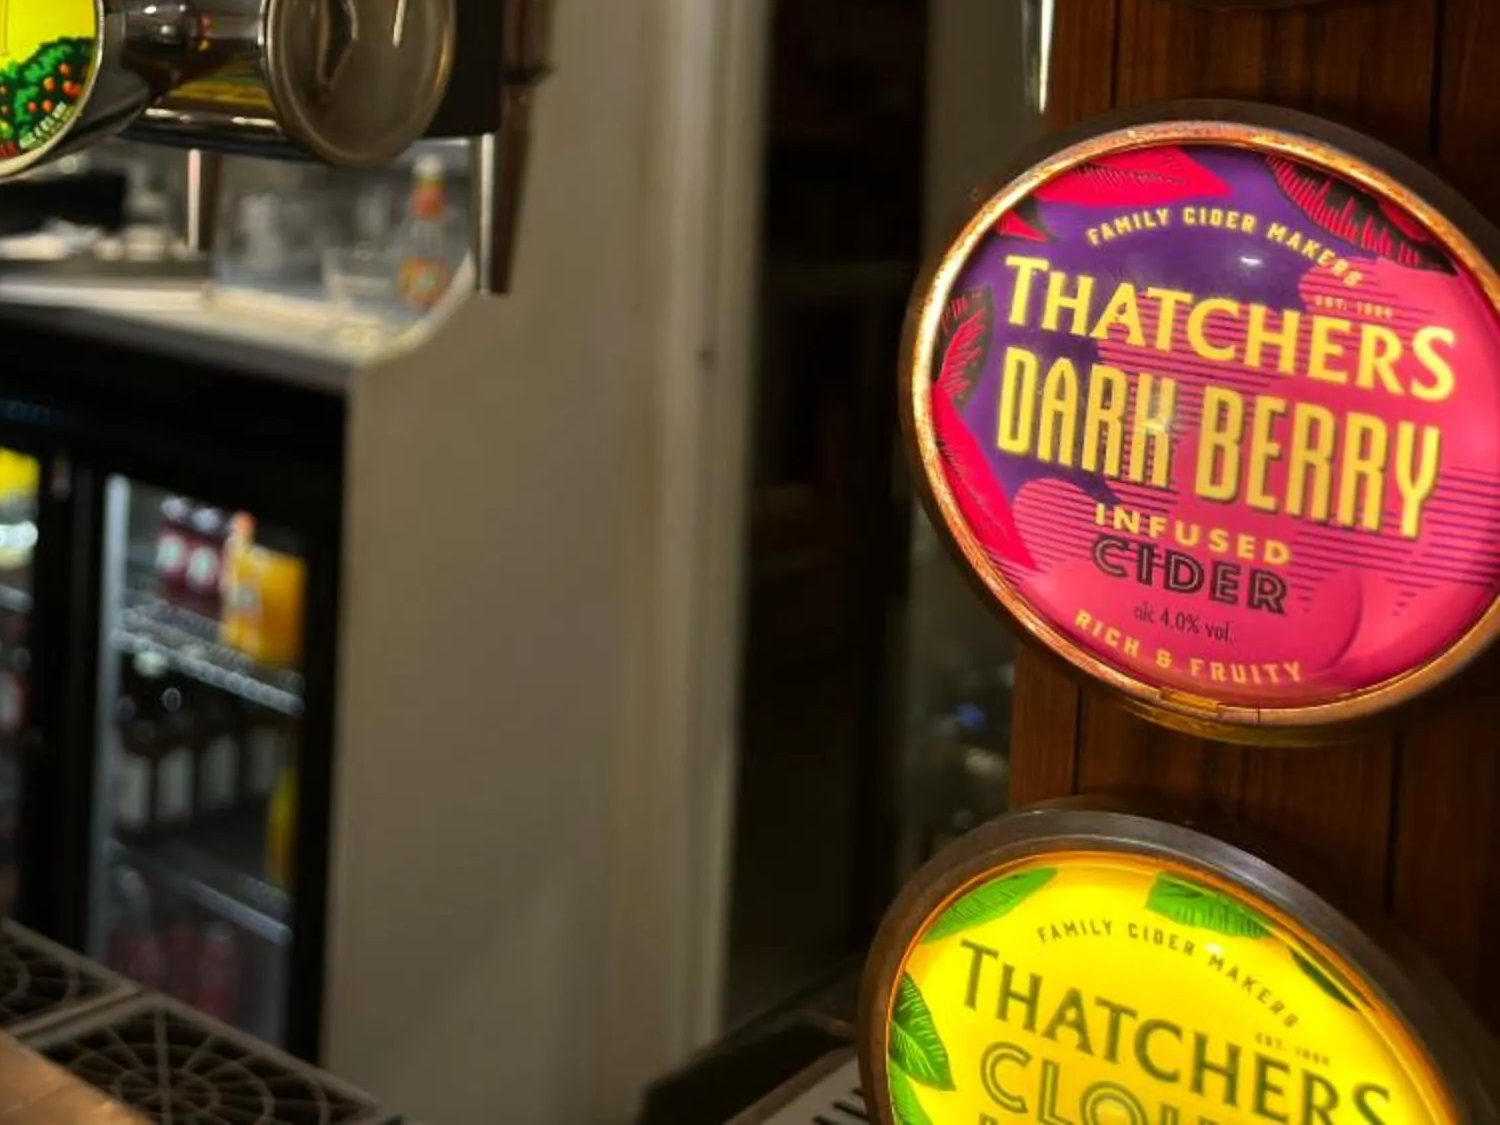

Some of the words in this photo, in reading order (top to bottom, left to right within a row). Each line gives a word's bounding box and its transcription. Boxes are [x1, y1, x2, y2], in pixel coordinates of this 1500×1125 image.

[1086, 208, 1170, 246] FAMILY
[1183, 206, 1257, 233] CIDER
[1265, 222, 1364, 287] MAKERS
[1005, 255, 1459, 403] THATCHERS
[996, 346, 1183, 489] DARK
[1195, 385, 1442, 541] BERRY
[1090, 533, 1290, 615] CIDER
[1095, 502, 1291, 566] INFUSED
[1075, 609, 1140, 659] RICH
[1156, 648, 1173, 669] &
[1190, 657, 1304, 686] FRUITY
[1133, 601, 1157, 623] alc
[1160, 606, 1201, 637] 4.0%
[1205, 616, 1234, 643] vol.
[1036, 920, 1114, 945] FAMILY
[1127, 923, 1196, 956] CIDER
[1208, 954, 1300, 1029] MAKERS
[959, 938, 1392, 1125] THATCHERS
[979, 1041, 1220, 1125] CLO
